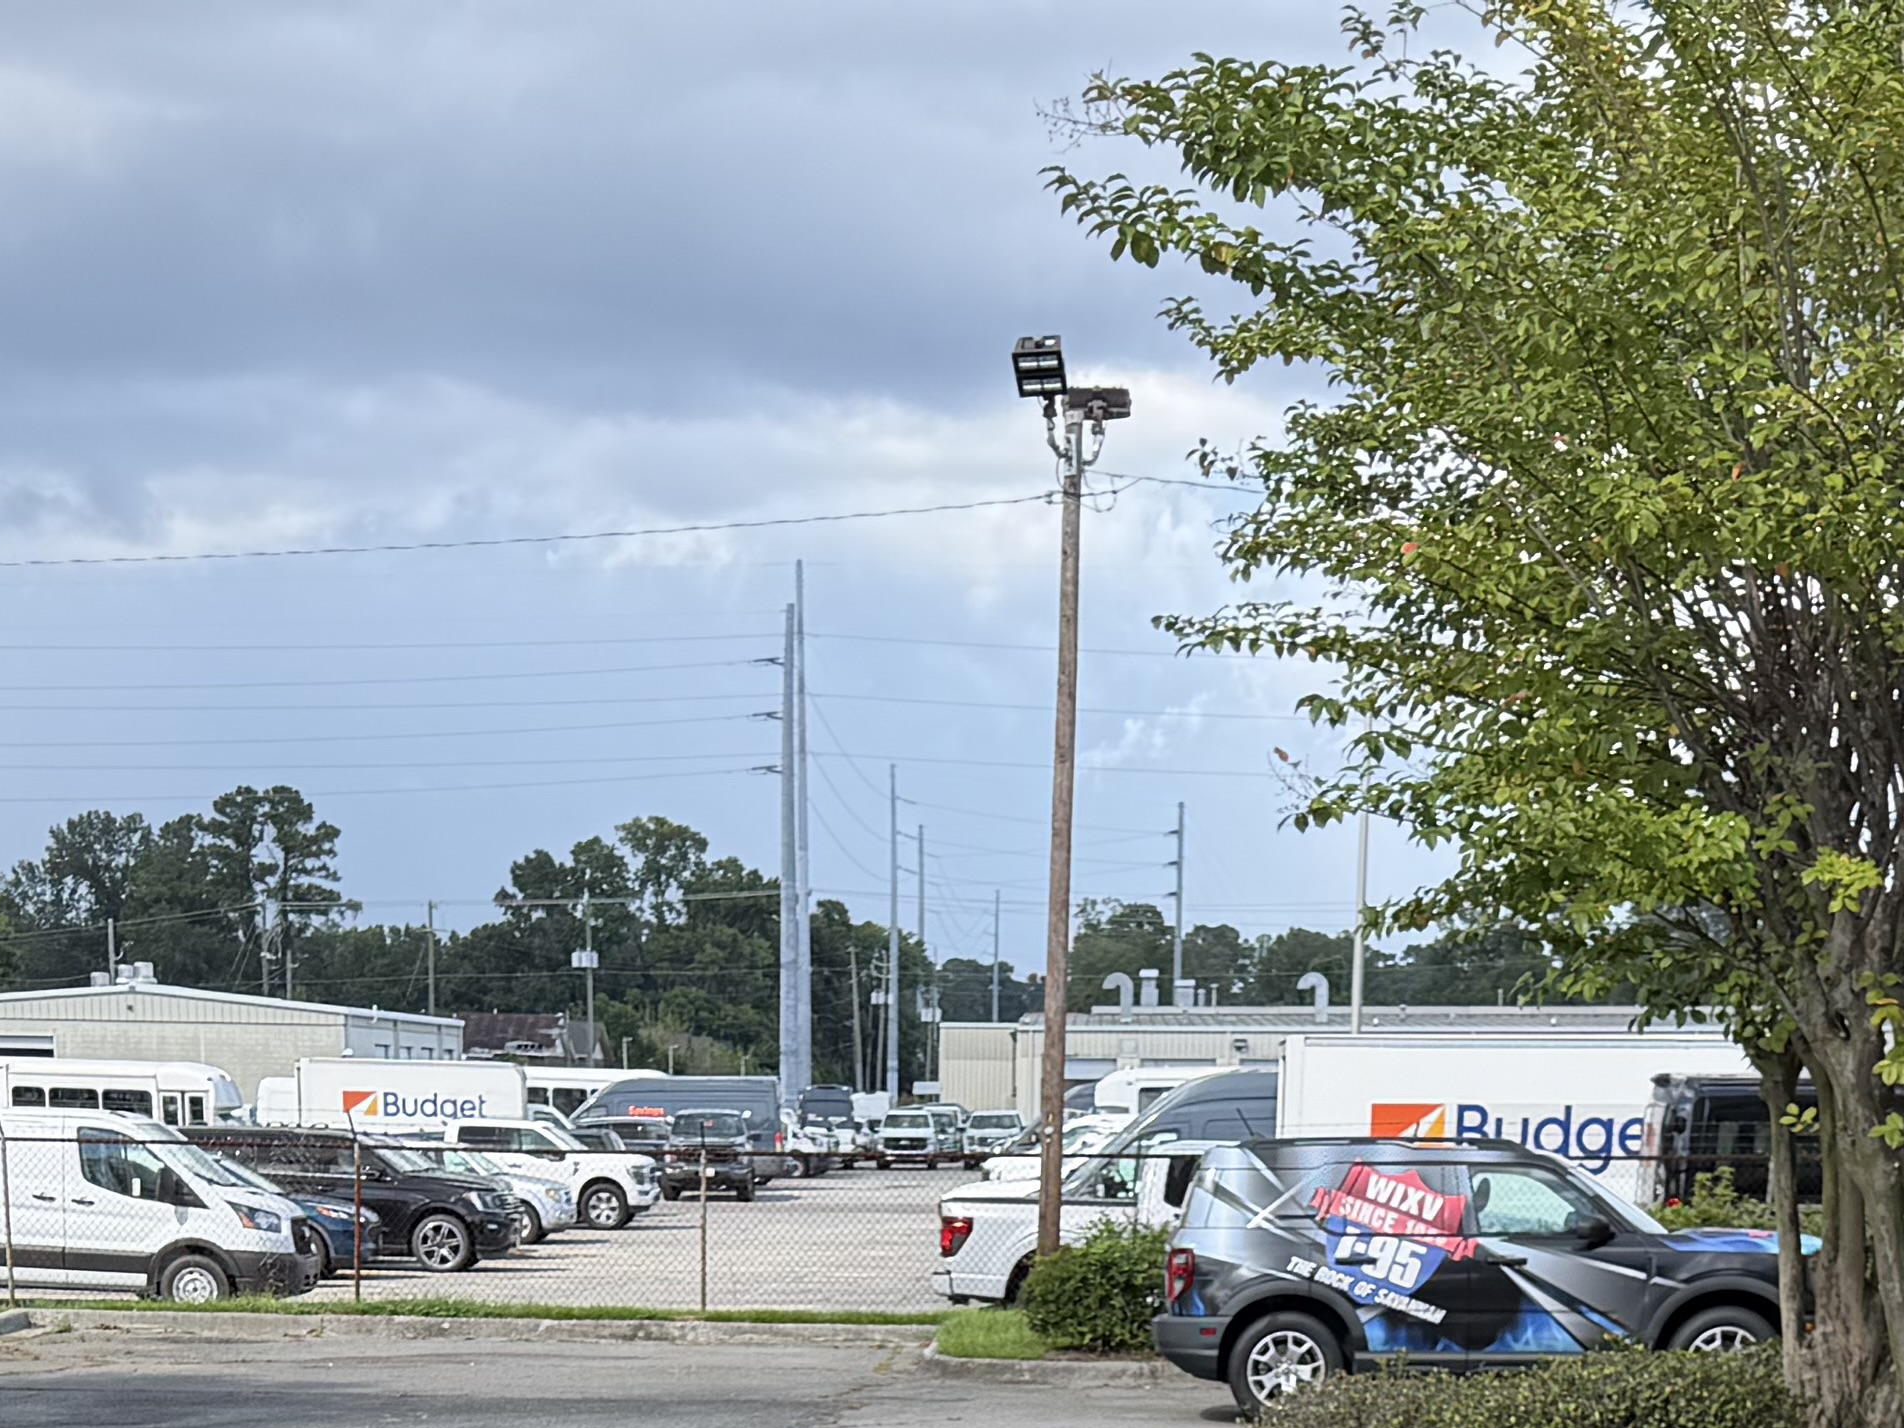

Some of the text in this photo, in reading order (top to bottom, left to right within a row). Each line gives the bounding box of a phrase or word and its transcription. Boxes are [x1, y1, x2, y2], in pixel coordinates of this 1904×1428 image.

[383, 1092, 487, 1119] Budget
[1457, 1104, 1645, 1175] Budge
[1338, 1197, 1400, 1233] SINCE
[1365, 1174, 1444, 1221] WIXV
[1286, 1255, 1317, 1278] THE
[1314, 1265, 1354, 1292] ROCK
[1353, 1281, 1377, 1298] OF
[1334, 1226, 1427, 1289] I-95
